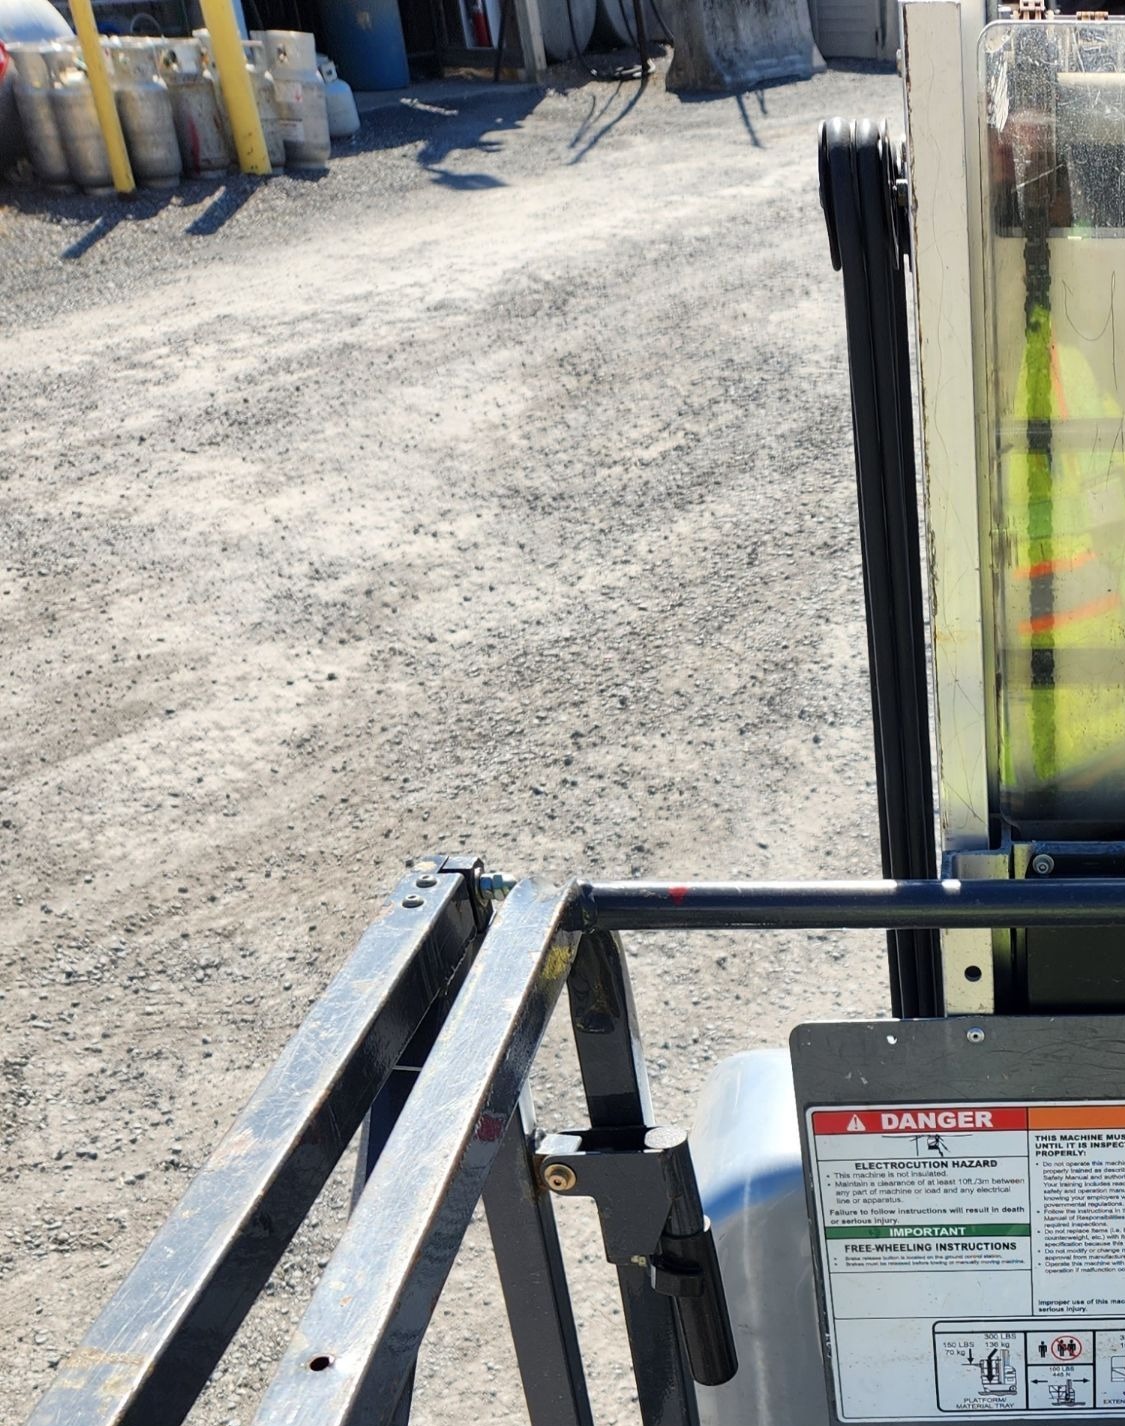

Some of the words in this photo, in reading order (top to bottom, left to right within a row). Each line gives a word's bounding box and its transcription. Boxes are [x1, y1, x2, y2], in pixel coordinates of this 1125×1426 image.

[881, 1111, 992, 1130] DANGER
[855, 1161, 948, 1170] ELECTROCUTION
[952, 1160, 998, 1168] HAZARD
[874, 1217, 900, 1226] injury.
[889, 1227, 965, 1237] IMPORTANT
[844, 1243, 932, 1253] FREE-WHEELING
[936, 1242, 1017, 1251] INSTRUCTIONS
